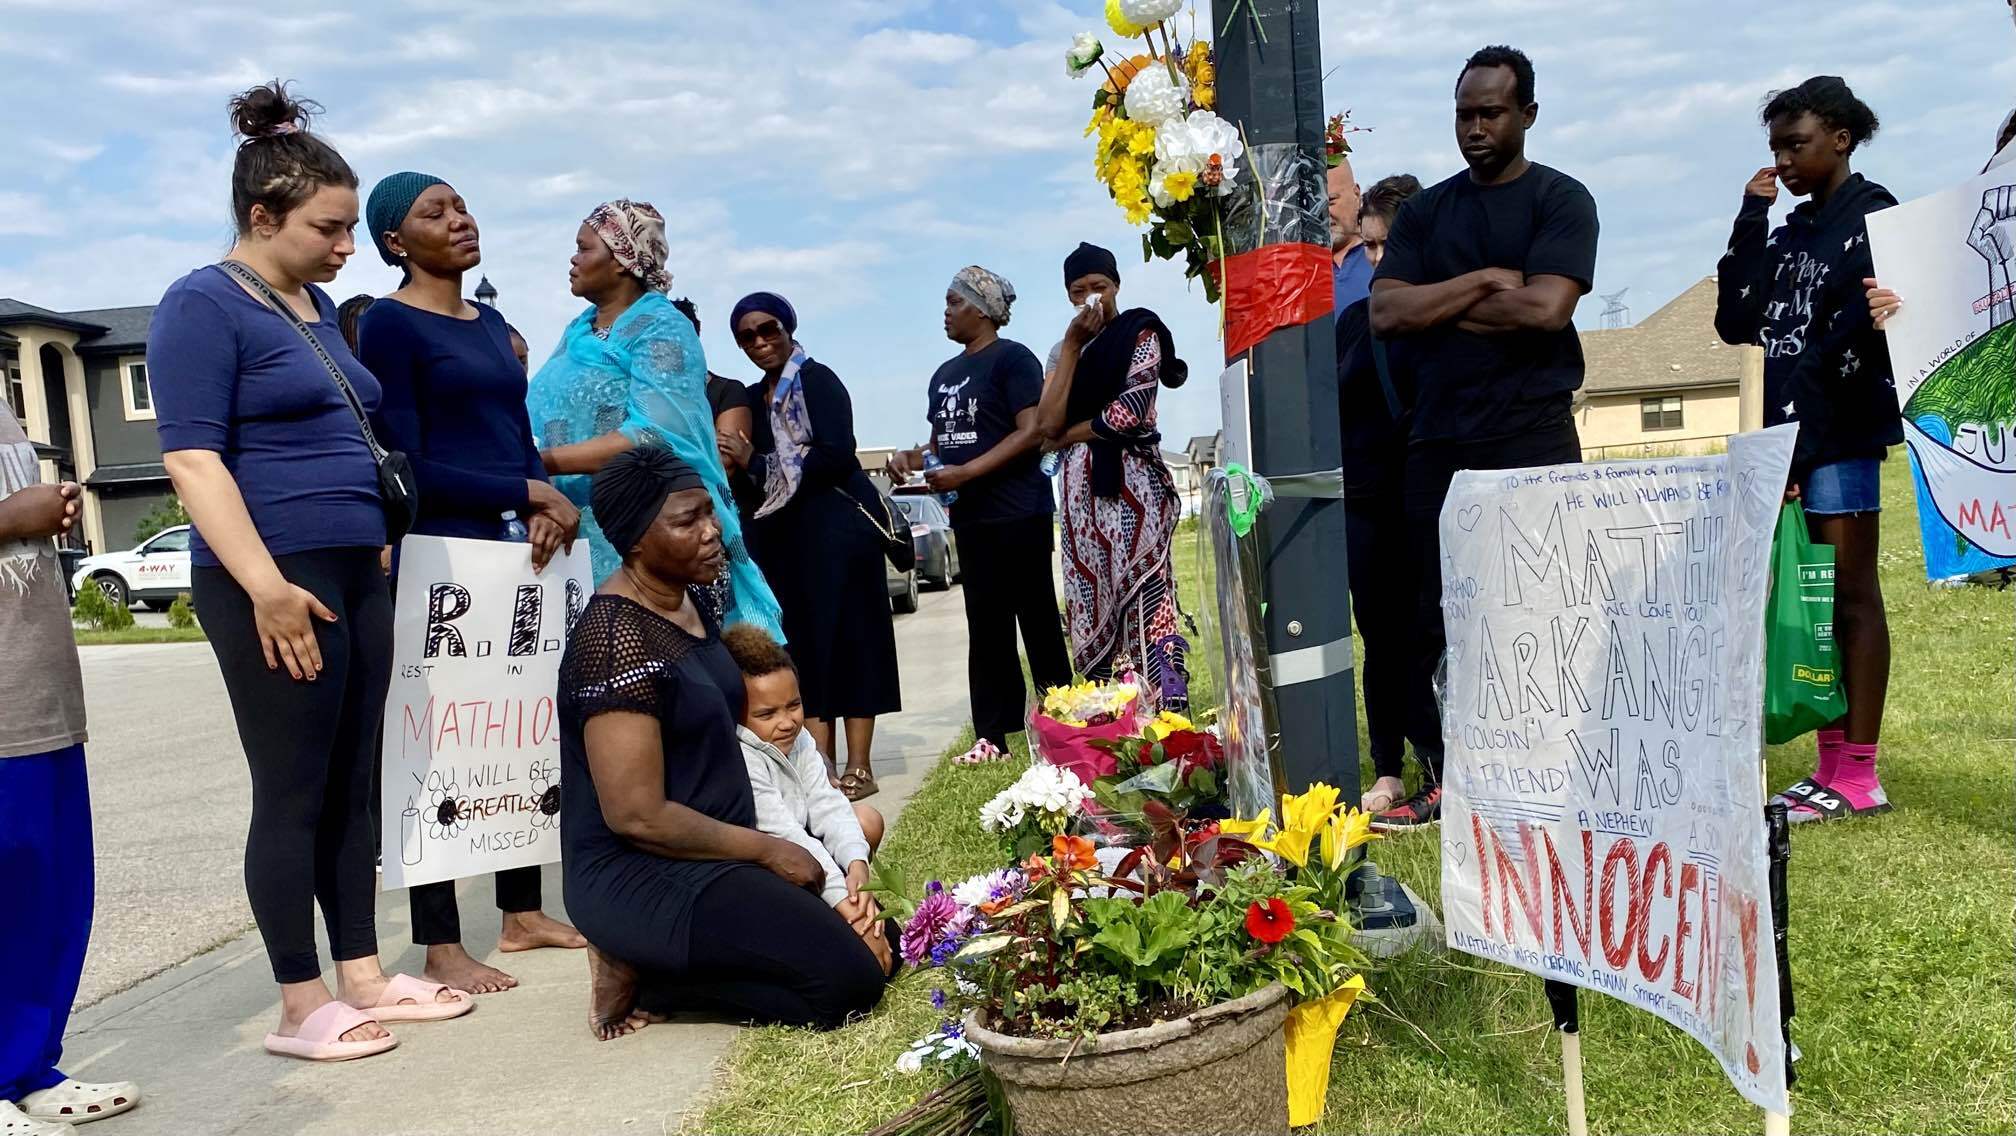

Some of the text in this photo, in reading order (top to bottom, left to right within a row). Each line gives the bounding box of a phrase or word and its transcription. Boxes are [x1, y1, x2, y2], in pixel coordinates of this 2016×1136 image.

[1907, 331, 1976, 389] IN A WORLD OF
[1958, 424, 2016, 465] JU
[1524, 474, 1542, 485] the
[1549, 469, 1589, 483] friends
[1605, 467, 1641, 482] family
[1643, 467, 1658, 478] of
[1564, 493, 1584, 511] HE
[1592, 490, 1628, 510] WILL
[1696, 482, 1712, 500] BE
[1499, 501, 1724, 608] MATHI
[1802, 571, 1816, 580] I'M
[1601, 603, 1629, 618] WE
[1639, 603, 1673, 619] LOVE
[401, 664, 523, 680] REST IN
[1478, 615, 1725, 737] ARKANGE
[402, 696, 561, 760] MATHIO
[412, 758, 551, 796] YOU WILL BE
[1566, 728, 1682, 811] WAS
[454, 794, 543, 821] GREATLY
[1578, 810, 1654, 837] A NEPHEW
[470, 827, 539, 855] MISSED
